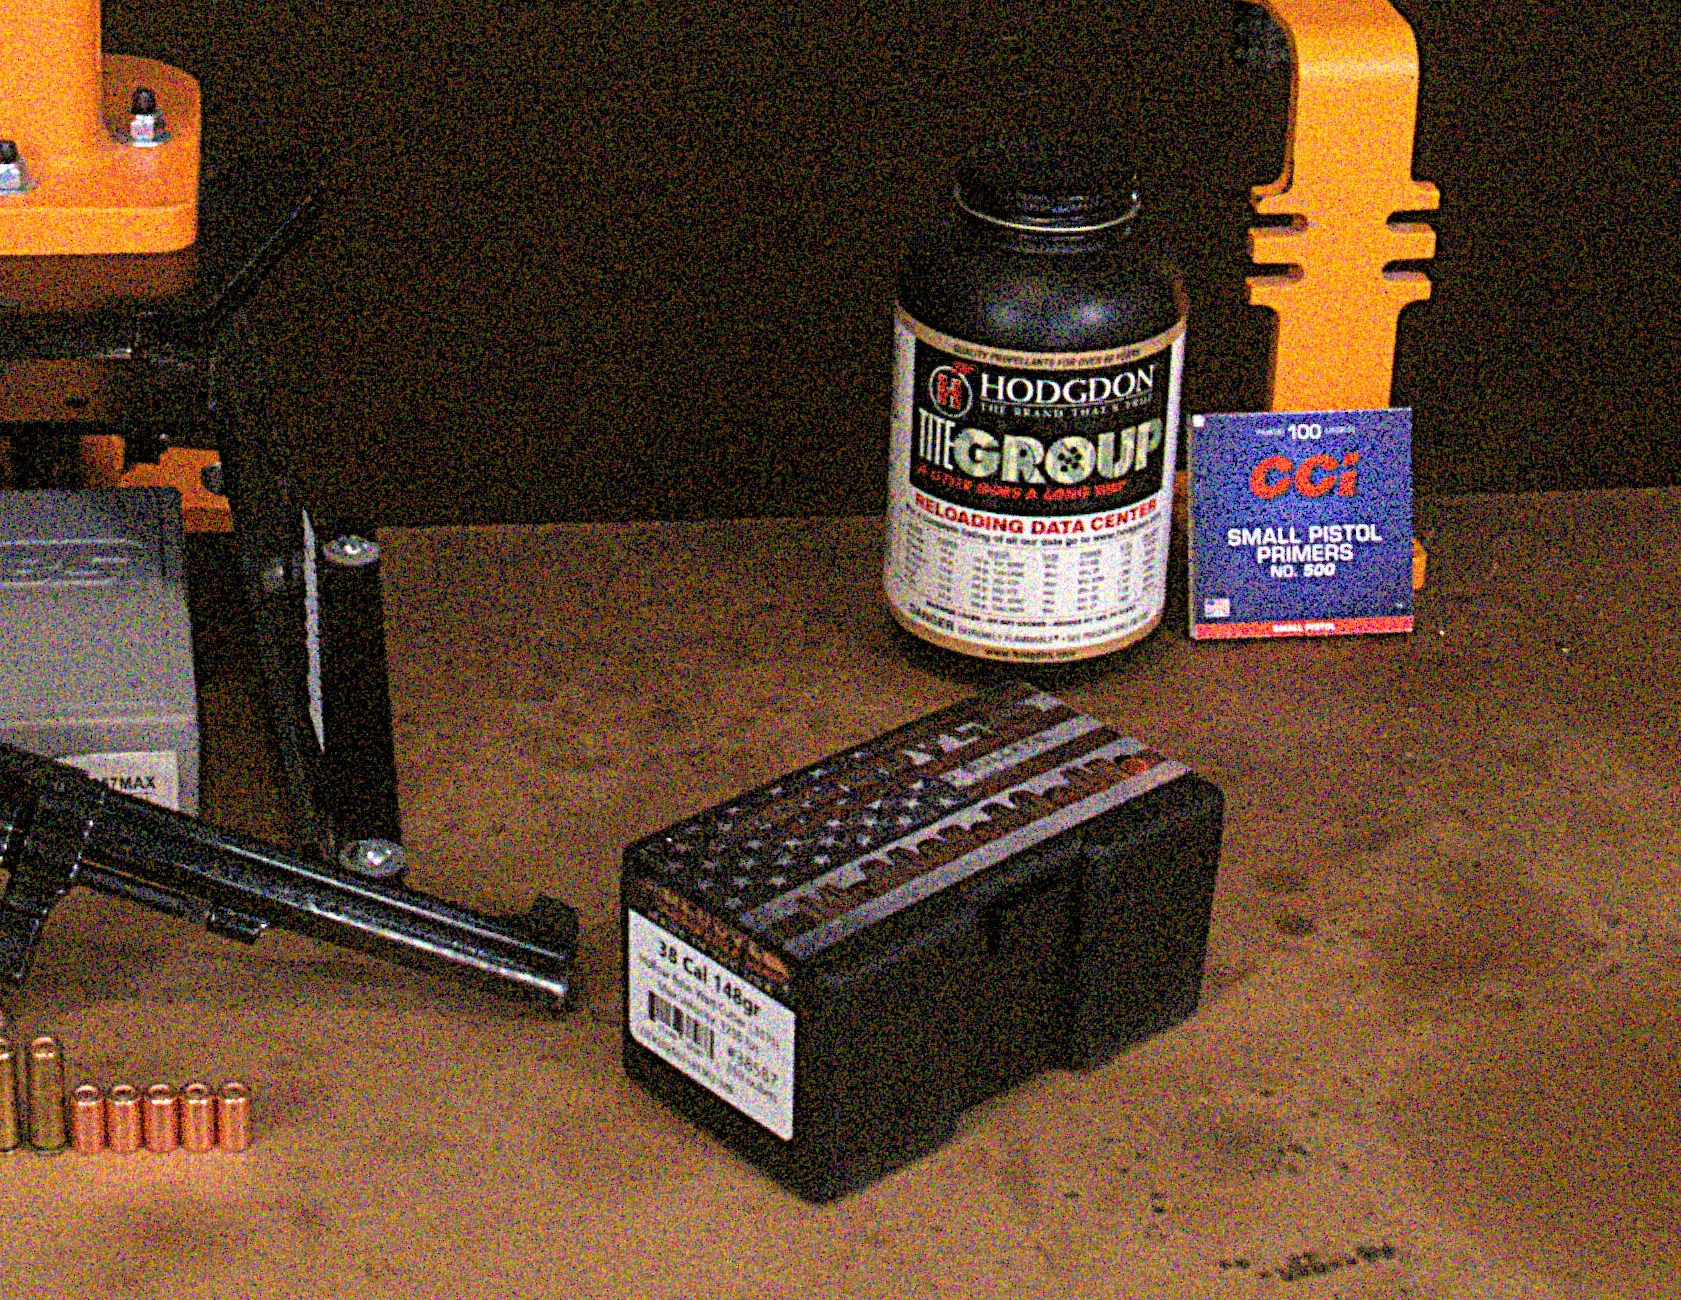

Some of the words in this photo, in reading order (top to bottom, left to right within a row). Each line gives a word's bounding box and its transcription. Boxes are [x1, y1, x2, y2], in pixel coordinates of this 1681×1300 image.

[980, 365, 1156, 404] HODGDON
[1287, 423, 1322, 440] 100
[914, 491, 1024, 534] RELOADING
[1031, 519, 1084, 535] DATA
[1090, 499, 1159, 531] CENTER
[1227, 525, 1302, 546] SMALL
[1309, 523, 1383, 544] PISTOL
[1256, 543, 1354, 564] PRIMERS
[1270, 564, 1298, 578] NO.
[1303, 562, 1336, 577] 500
[658, 939, 678, 964] 38
[682, 956, 709, 984] Cal
[714, 974, 761, 1017] 148gr
